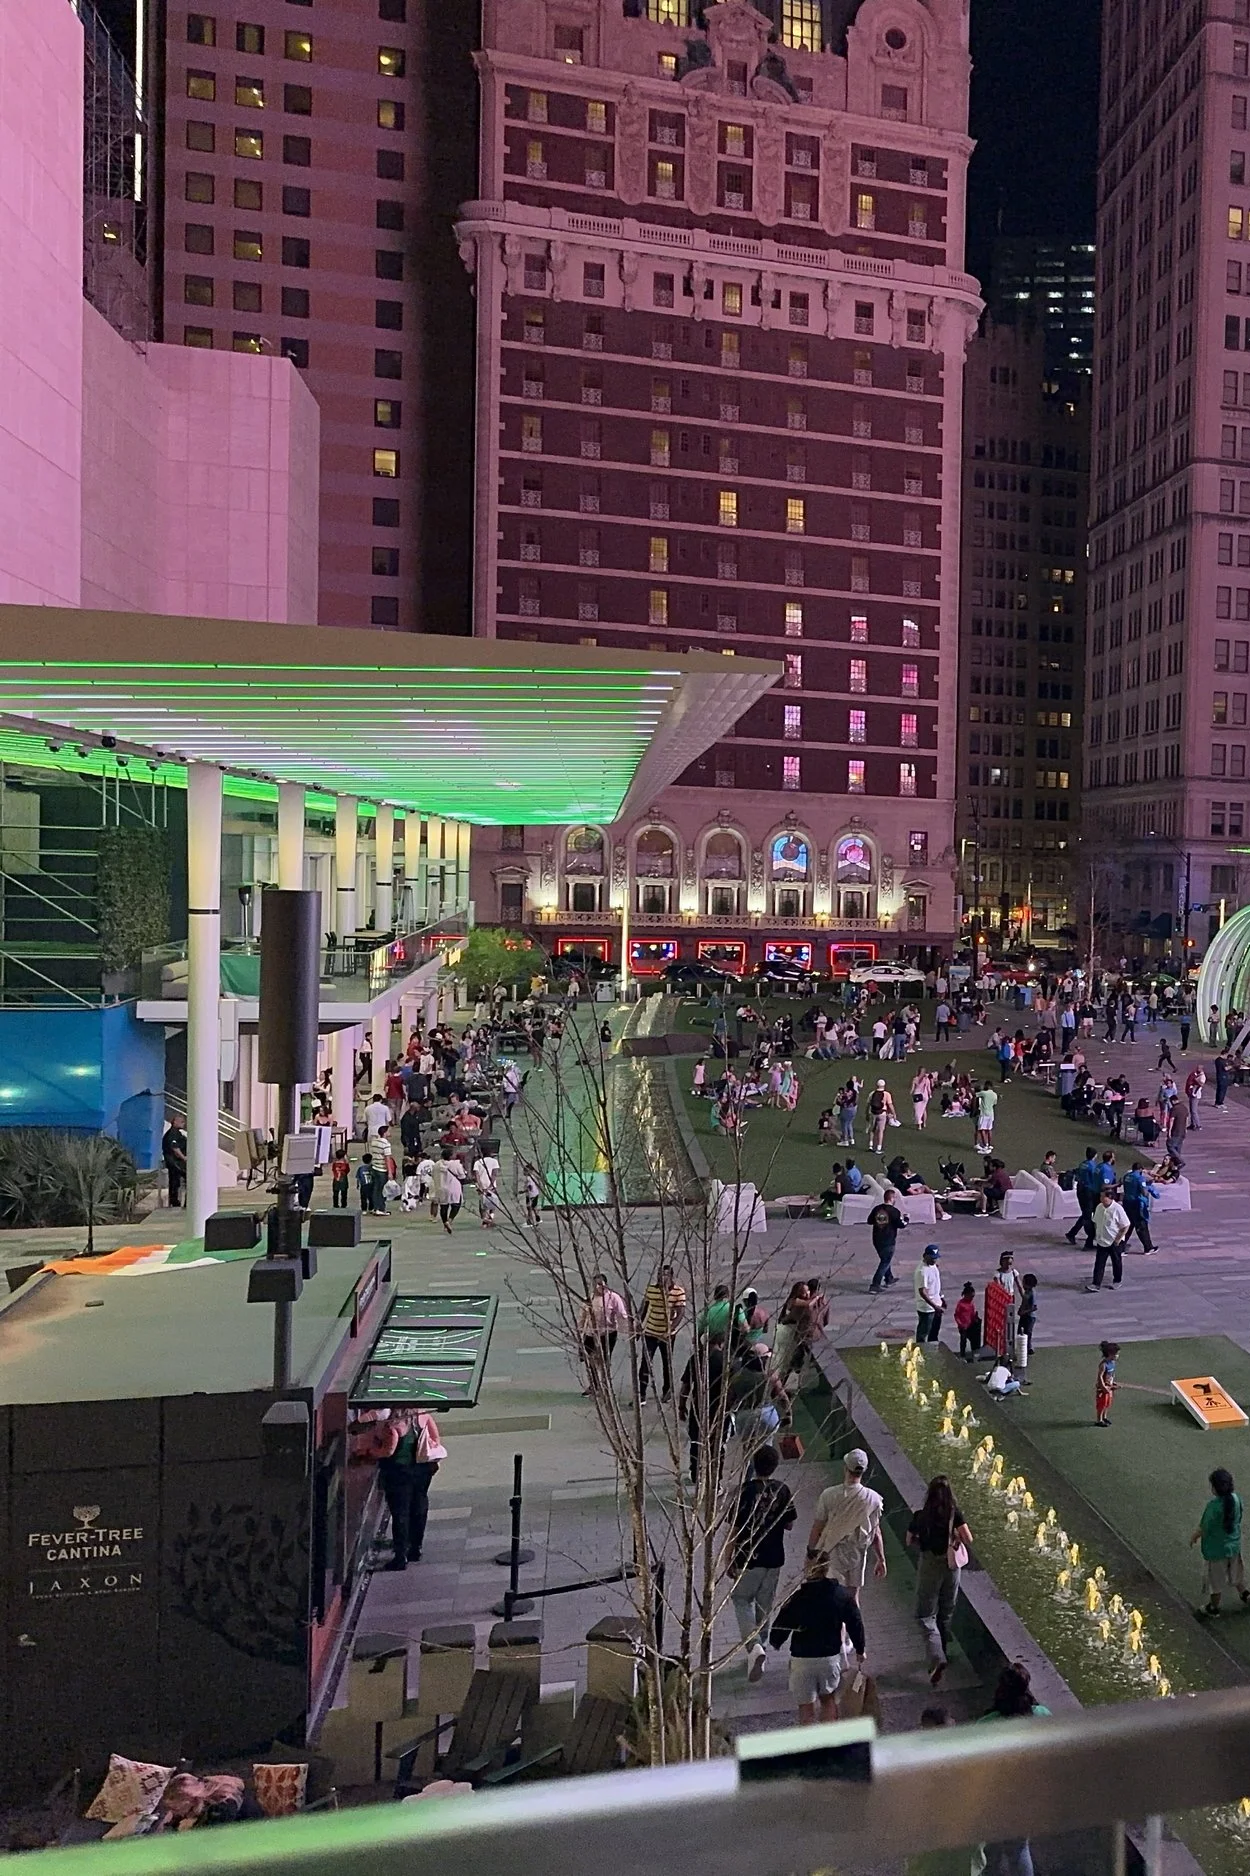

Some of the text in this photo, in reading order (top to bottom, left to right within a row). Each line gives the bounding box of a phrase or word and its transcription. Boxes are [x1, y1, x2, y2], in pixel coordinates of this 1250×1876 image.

[28, 1528, 144, 1547] FEVER-TREE
[46, 1544, 122, 1561] CANTINA
[28, 1573, 143, 1594] JAXON
